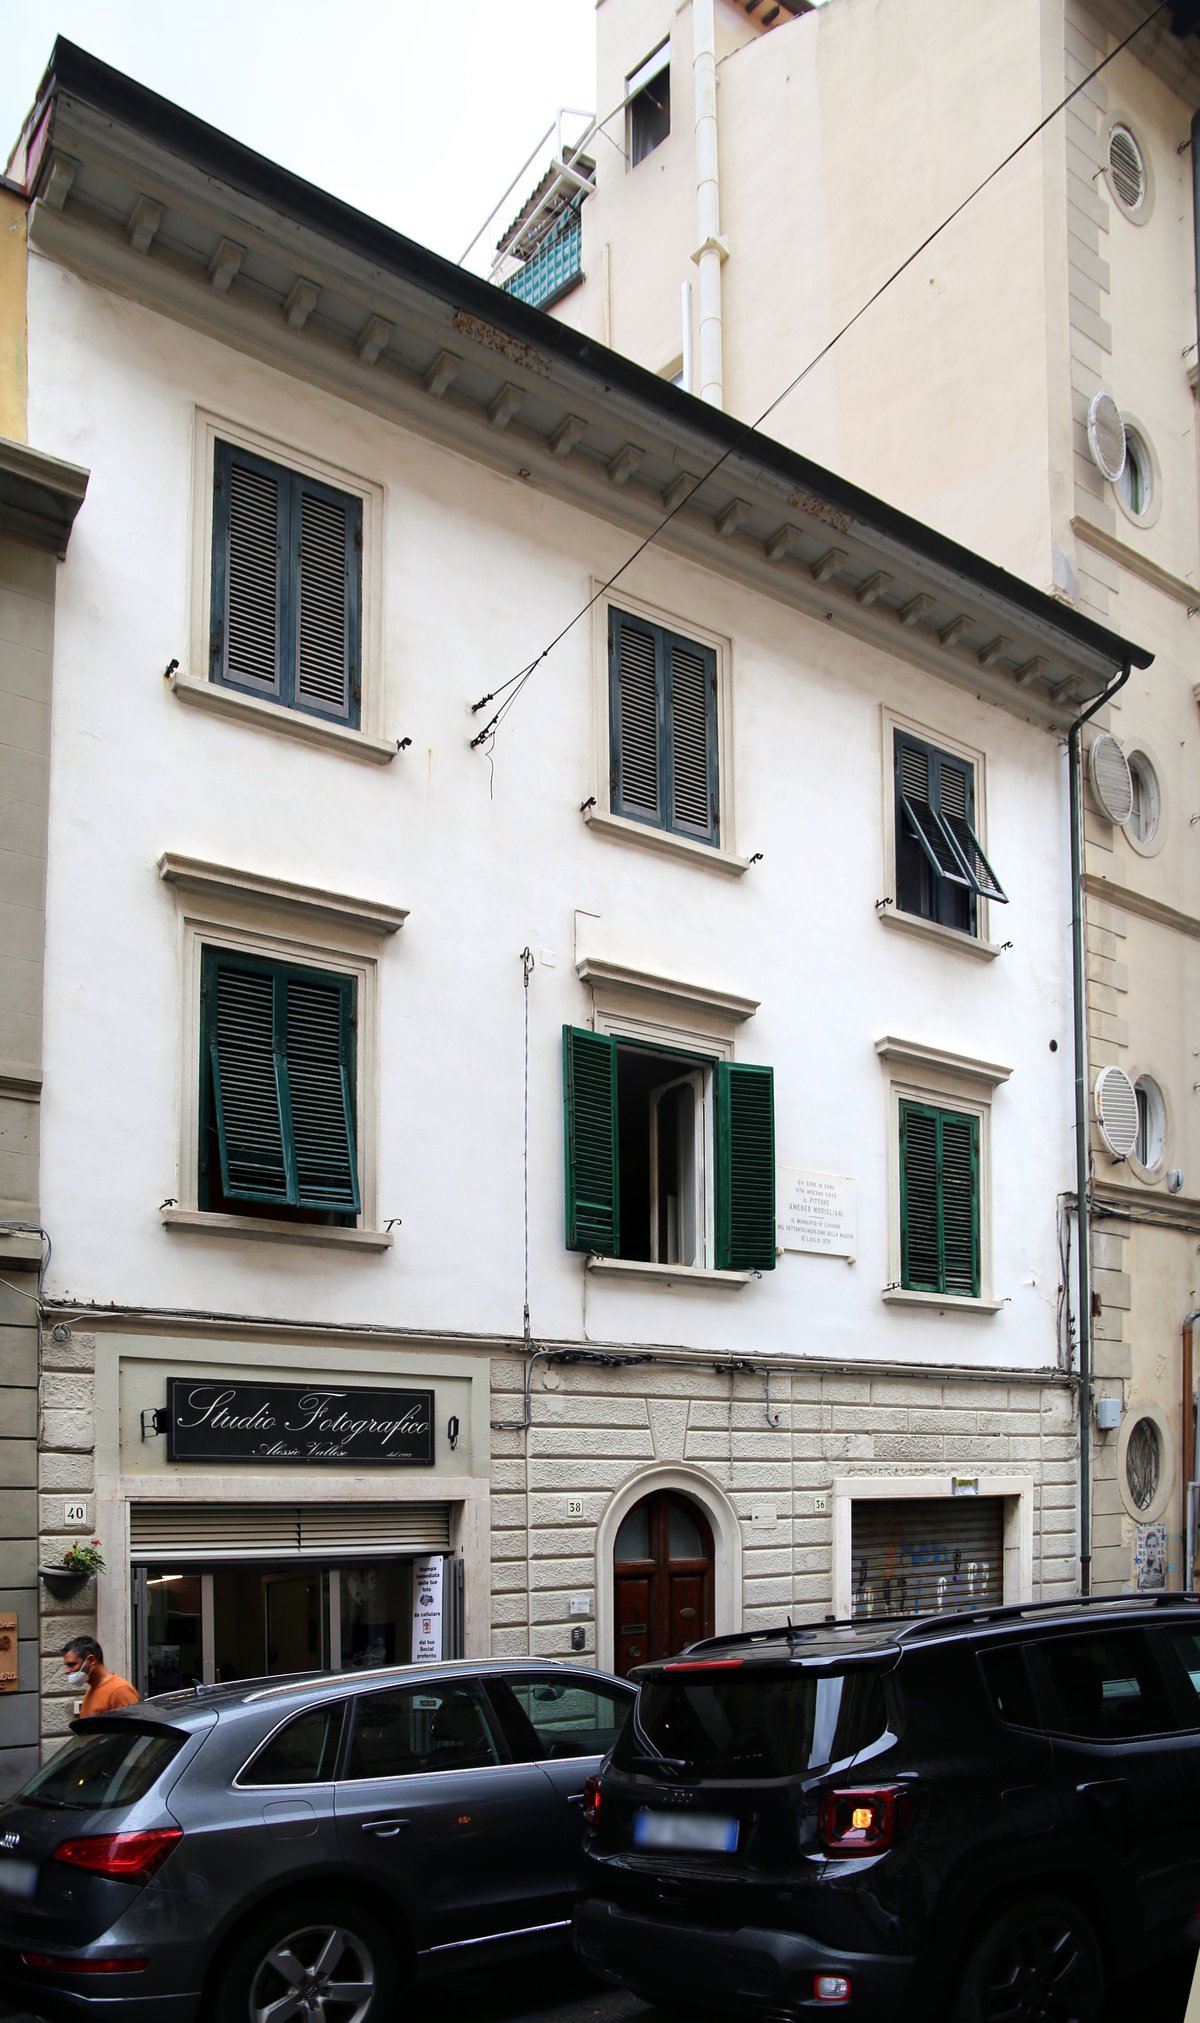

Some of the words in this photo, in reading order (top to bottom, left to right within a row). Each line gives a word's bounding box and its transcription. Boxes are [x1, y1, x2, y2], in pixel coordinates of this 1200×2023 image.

[809, 1197, 830, 1207] PITTORE
[789, 1203, 812, 1213] AMEDEO
[813, 1206, 844, 1217] MODIGLIANI
[177, 1387, 276, 1430] Studio
[284, 1392, 430, 1445] Fotografico
[252, 1440, 301, 1456] Alessio
[569, 1502, 581, 1513] 38
[815, 1500, 825, 1509] 36
[67, 1507, 84, 1519] 40
